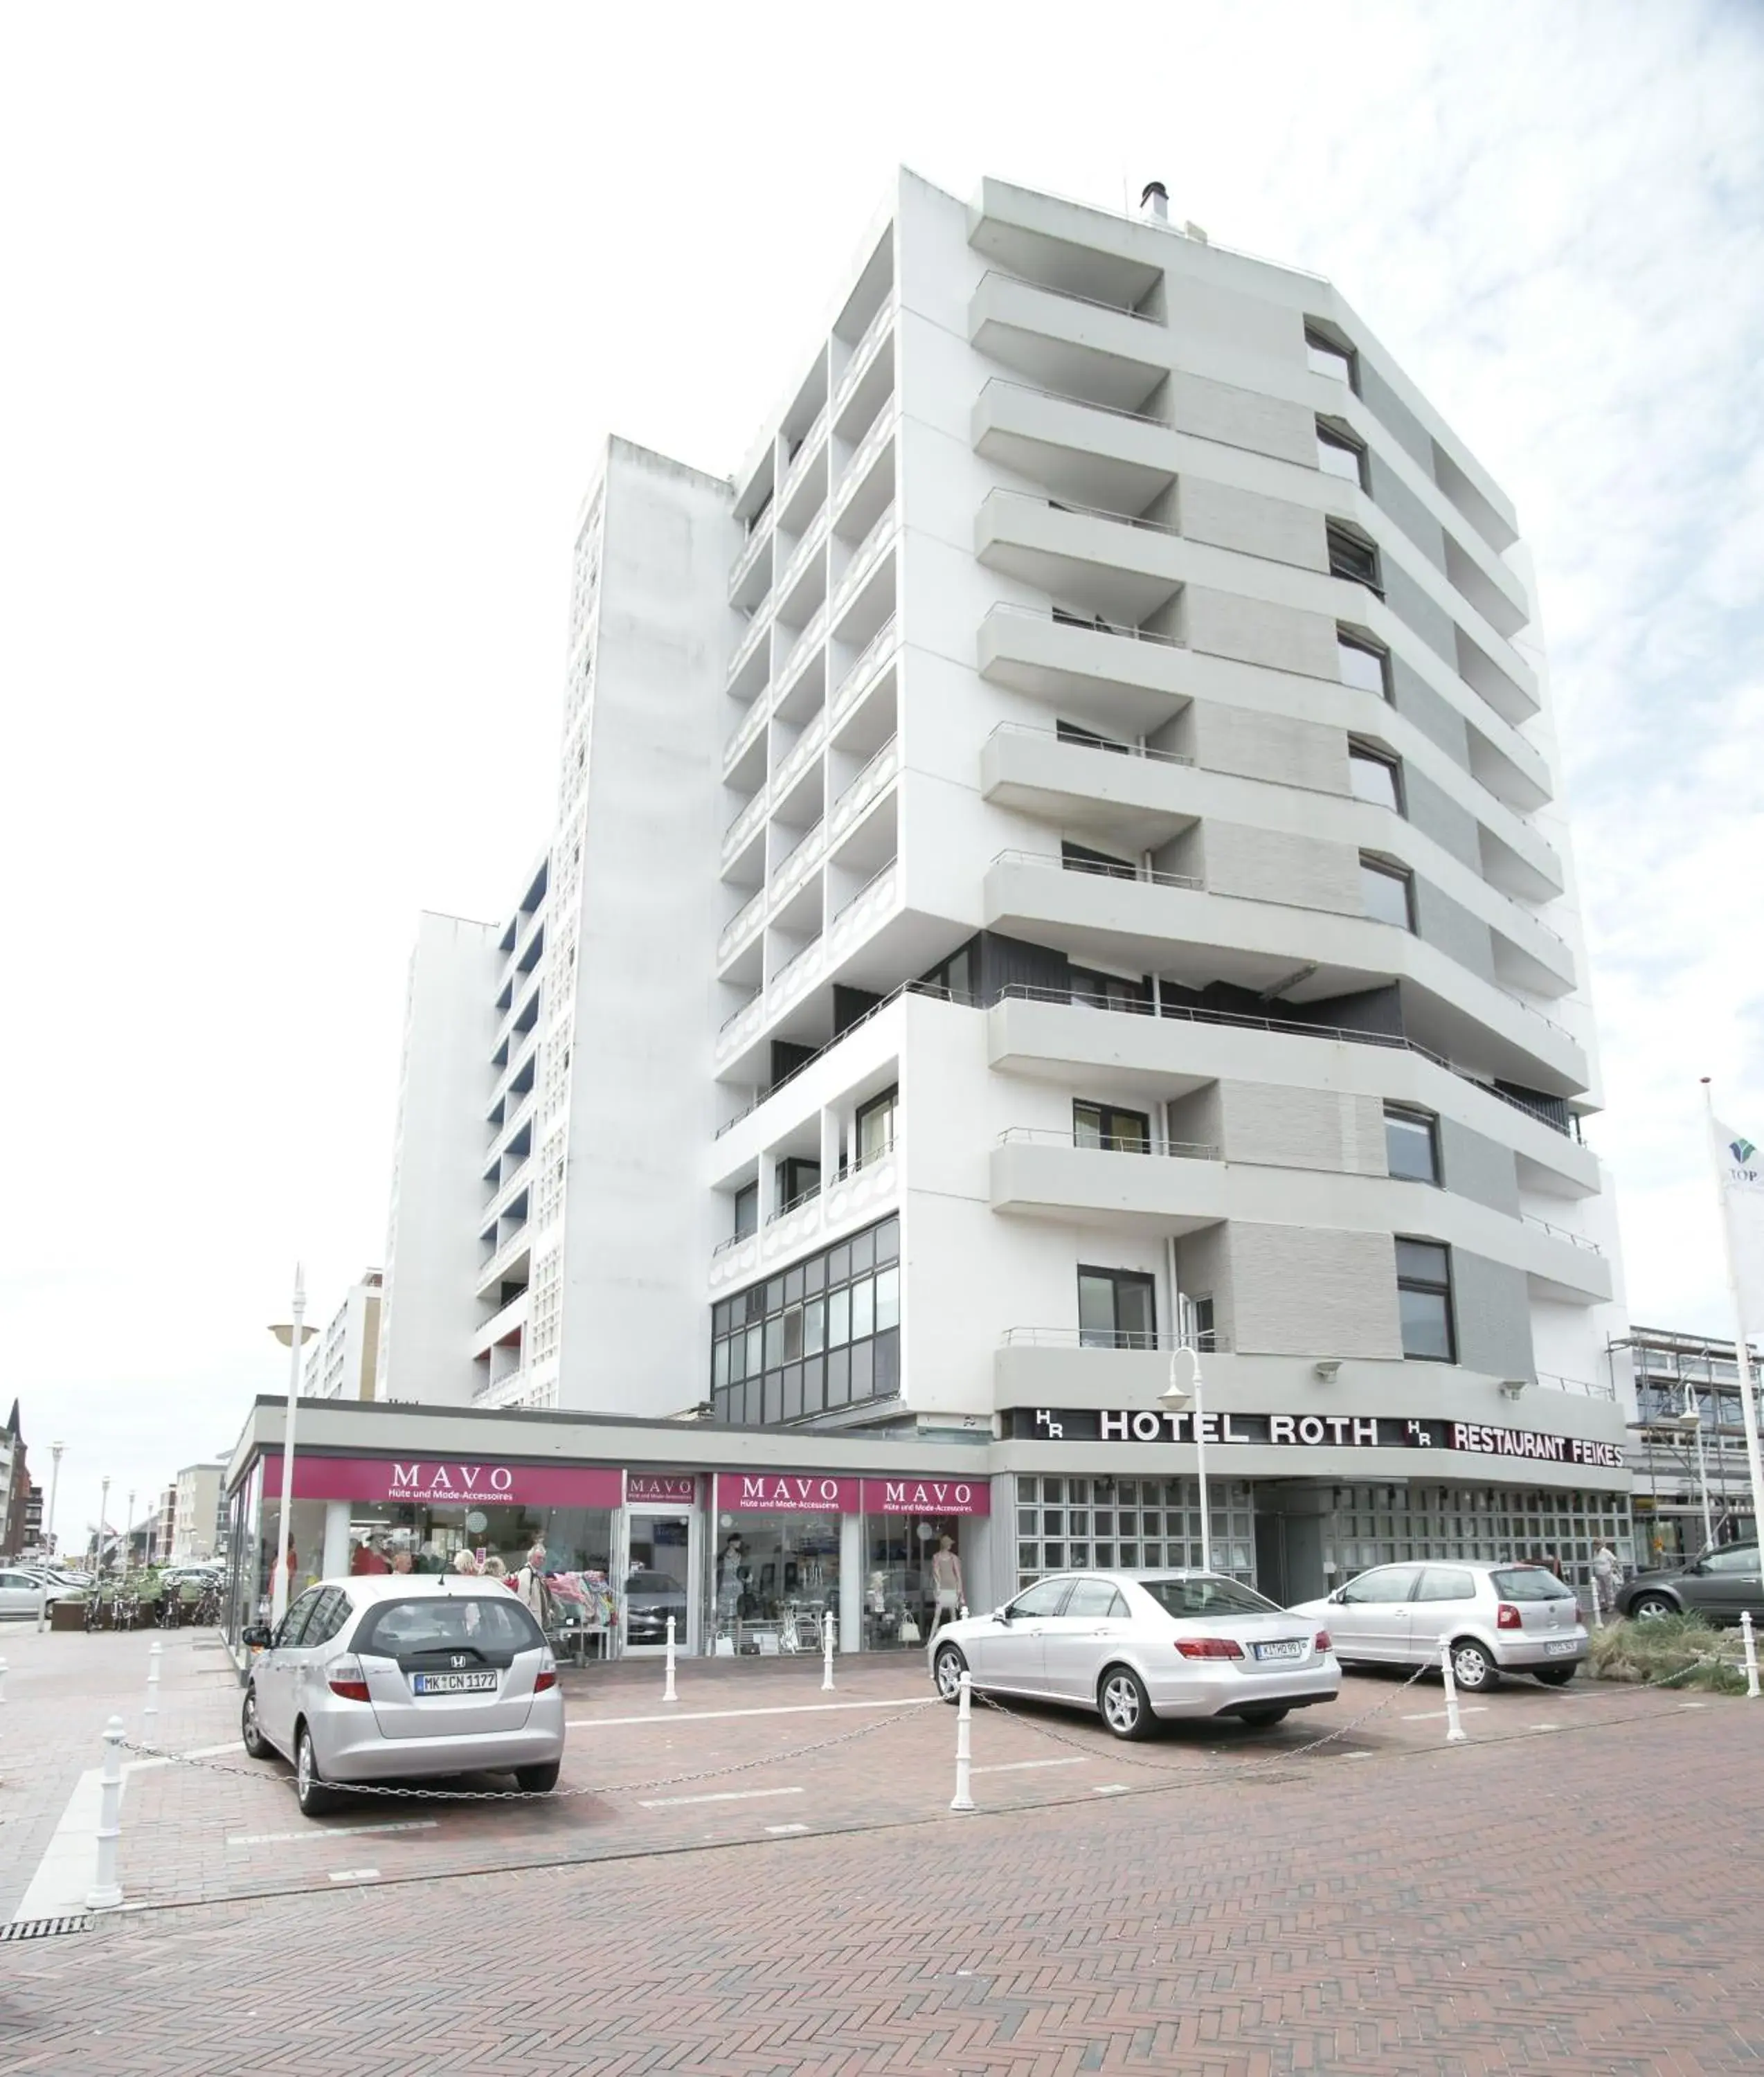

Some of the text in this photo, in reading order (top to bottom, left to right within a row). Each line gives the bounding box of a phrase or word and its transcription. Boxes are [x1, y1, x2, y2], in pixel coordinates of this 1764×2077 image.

[1728, 1167, 1758, 1182] TOP
[1100, 1410, 1250, 1442] HOTEL
[1270, 1415, 1378, 1446] ROTH
[1453, 1422, 1566, 1462] RESTAURANT
[1572, 1439, 1625, 1467] FEIKES
[392, 1463, 512, 1491] MAVO
[631, 1479, 692, 1494] MAVO
[388, 1489, 411, 1498] Hüte
[413, 1489, 431, 1498] und
[741, 1476, 838, 1501] MAVO
[885, 1482, 971, 1504] MAVO
[424, 1673, 494, 1690] MK CN 1177
